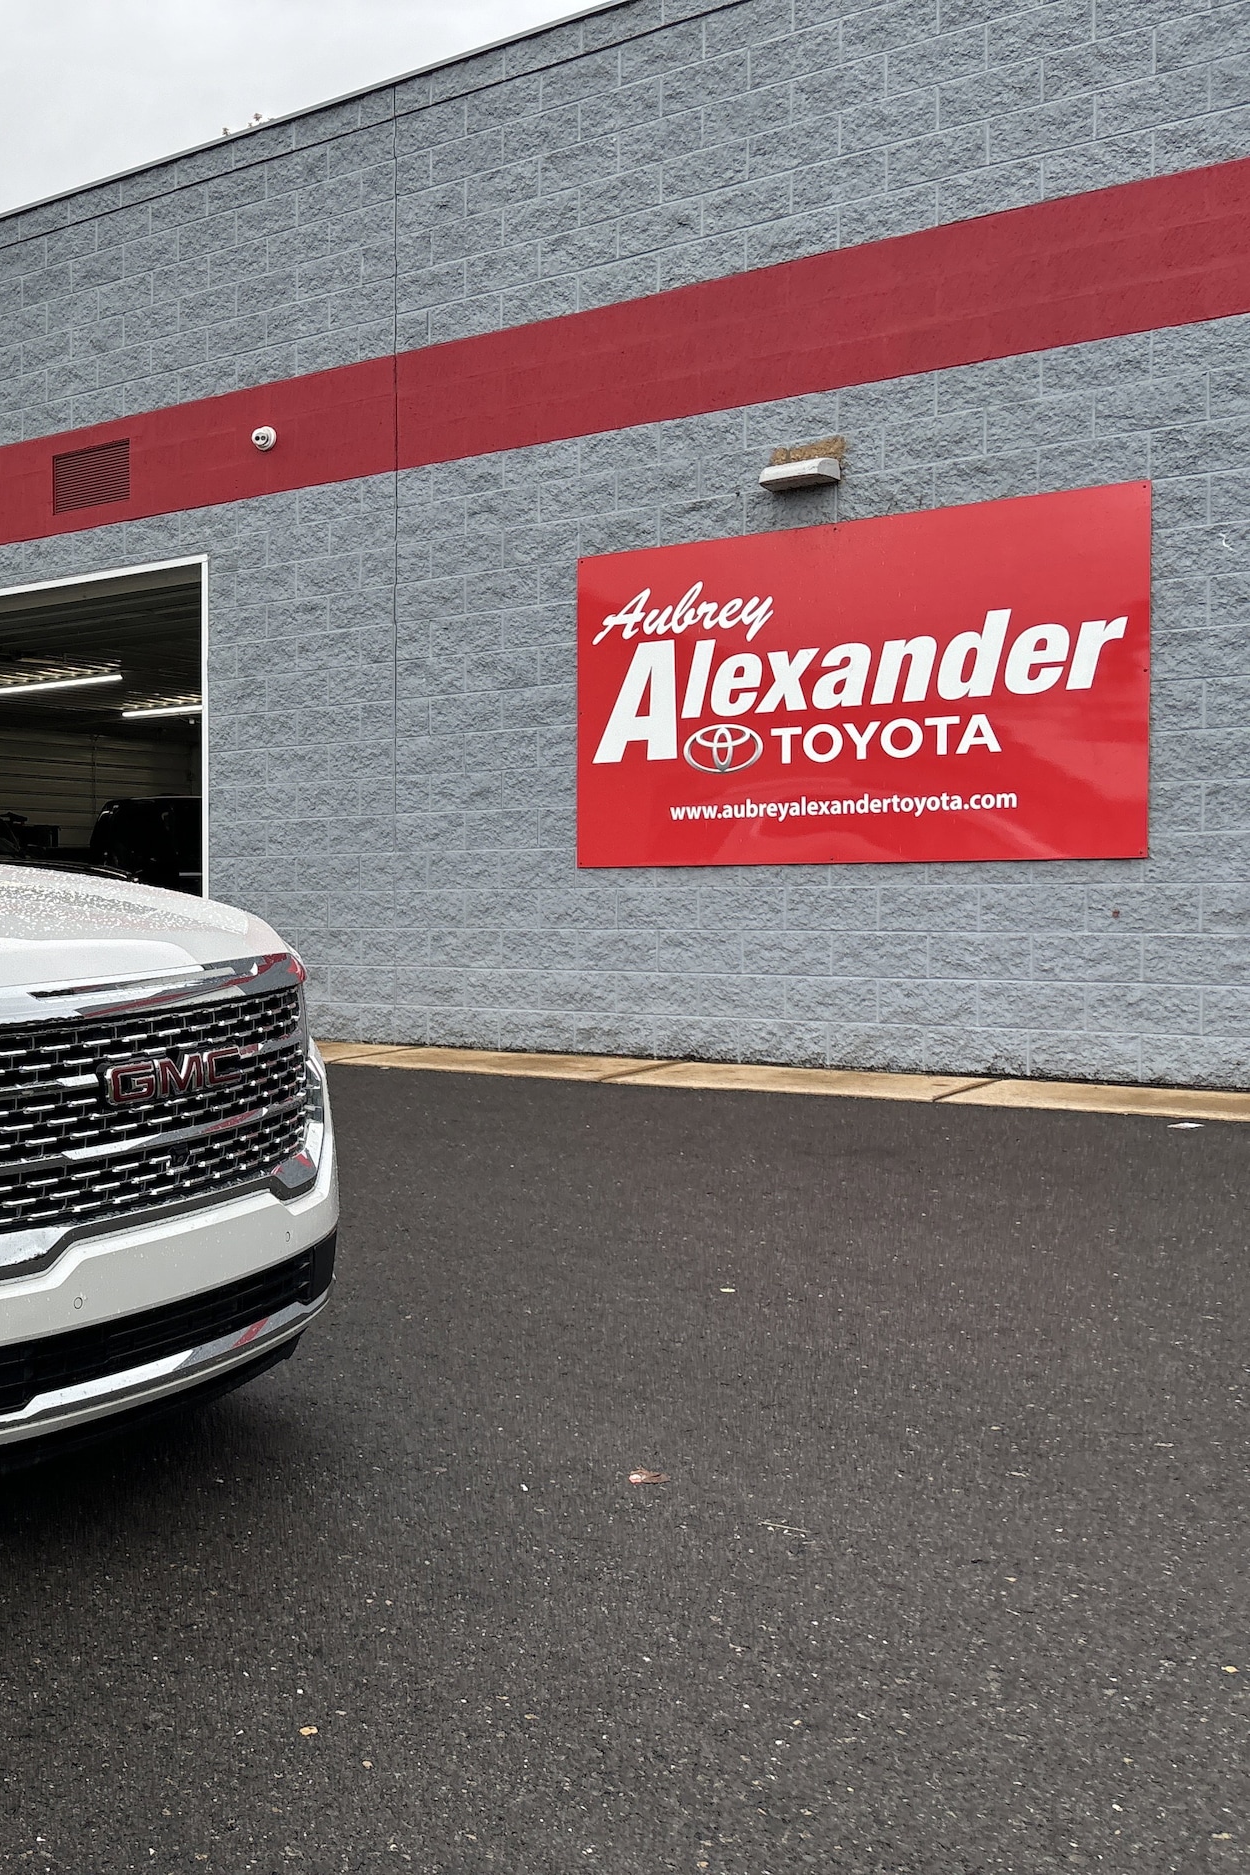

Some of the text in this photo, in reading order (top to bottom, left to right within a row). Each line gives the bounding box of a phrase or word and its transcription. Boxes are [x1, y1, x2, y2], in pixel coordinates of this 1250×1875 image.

[591, 580, 774, 646] Aubrey
[591, 608, 1129, 765] Alexander
[770, 713, 1003, 765] TOYOTA
[669, 791, 1018, 823] www.aubreyalexandertoyota.com
[106, 1046, 241, 1105] GMC
